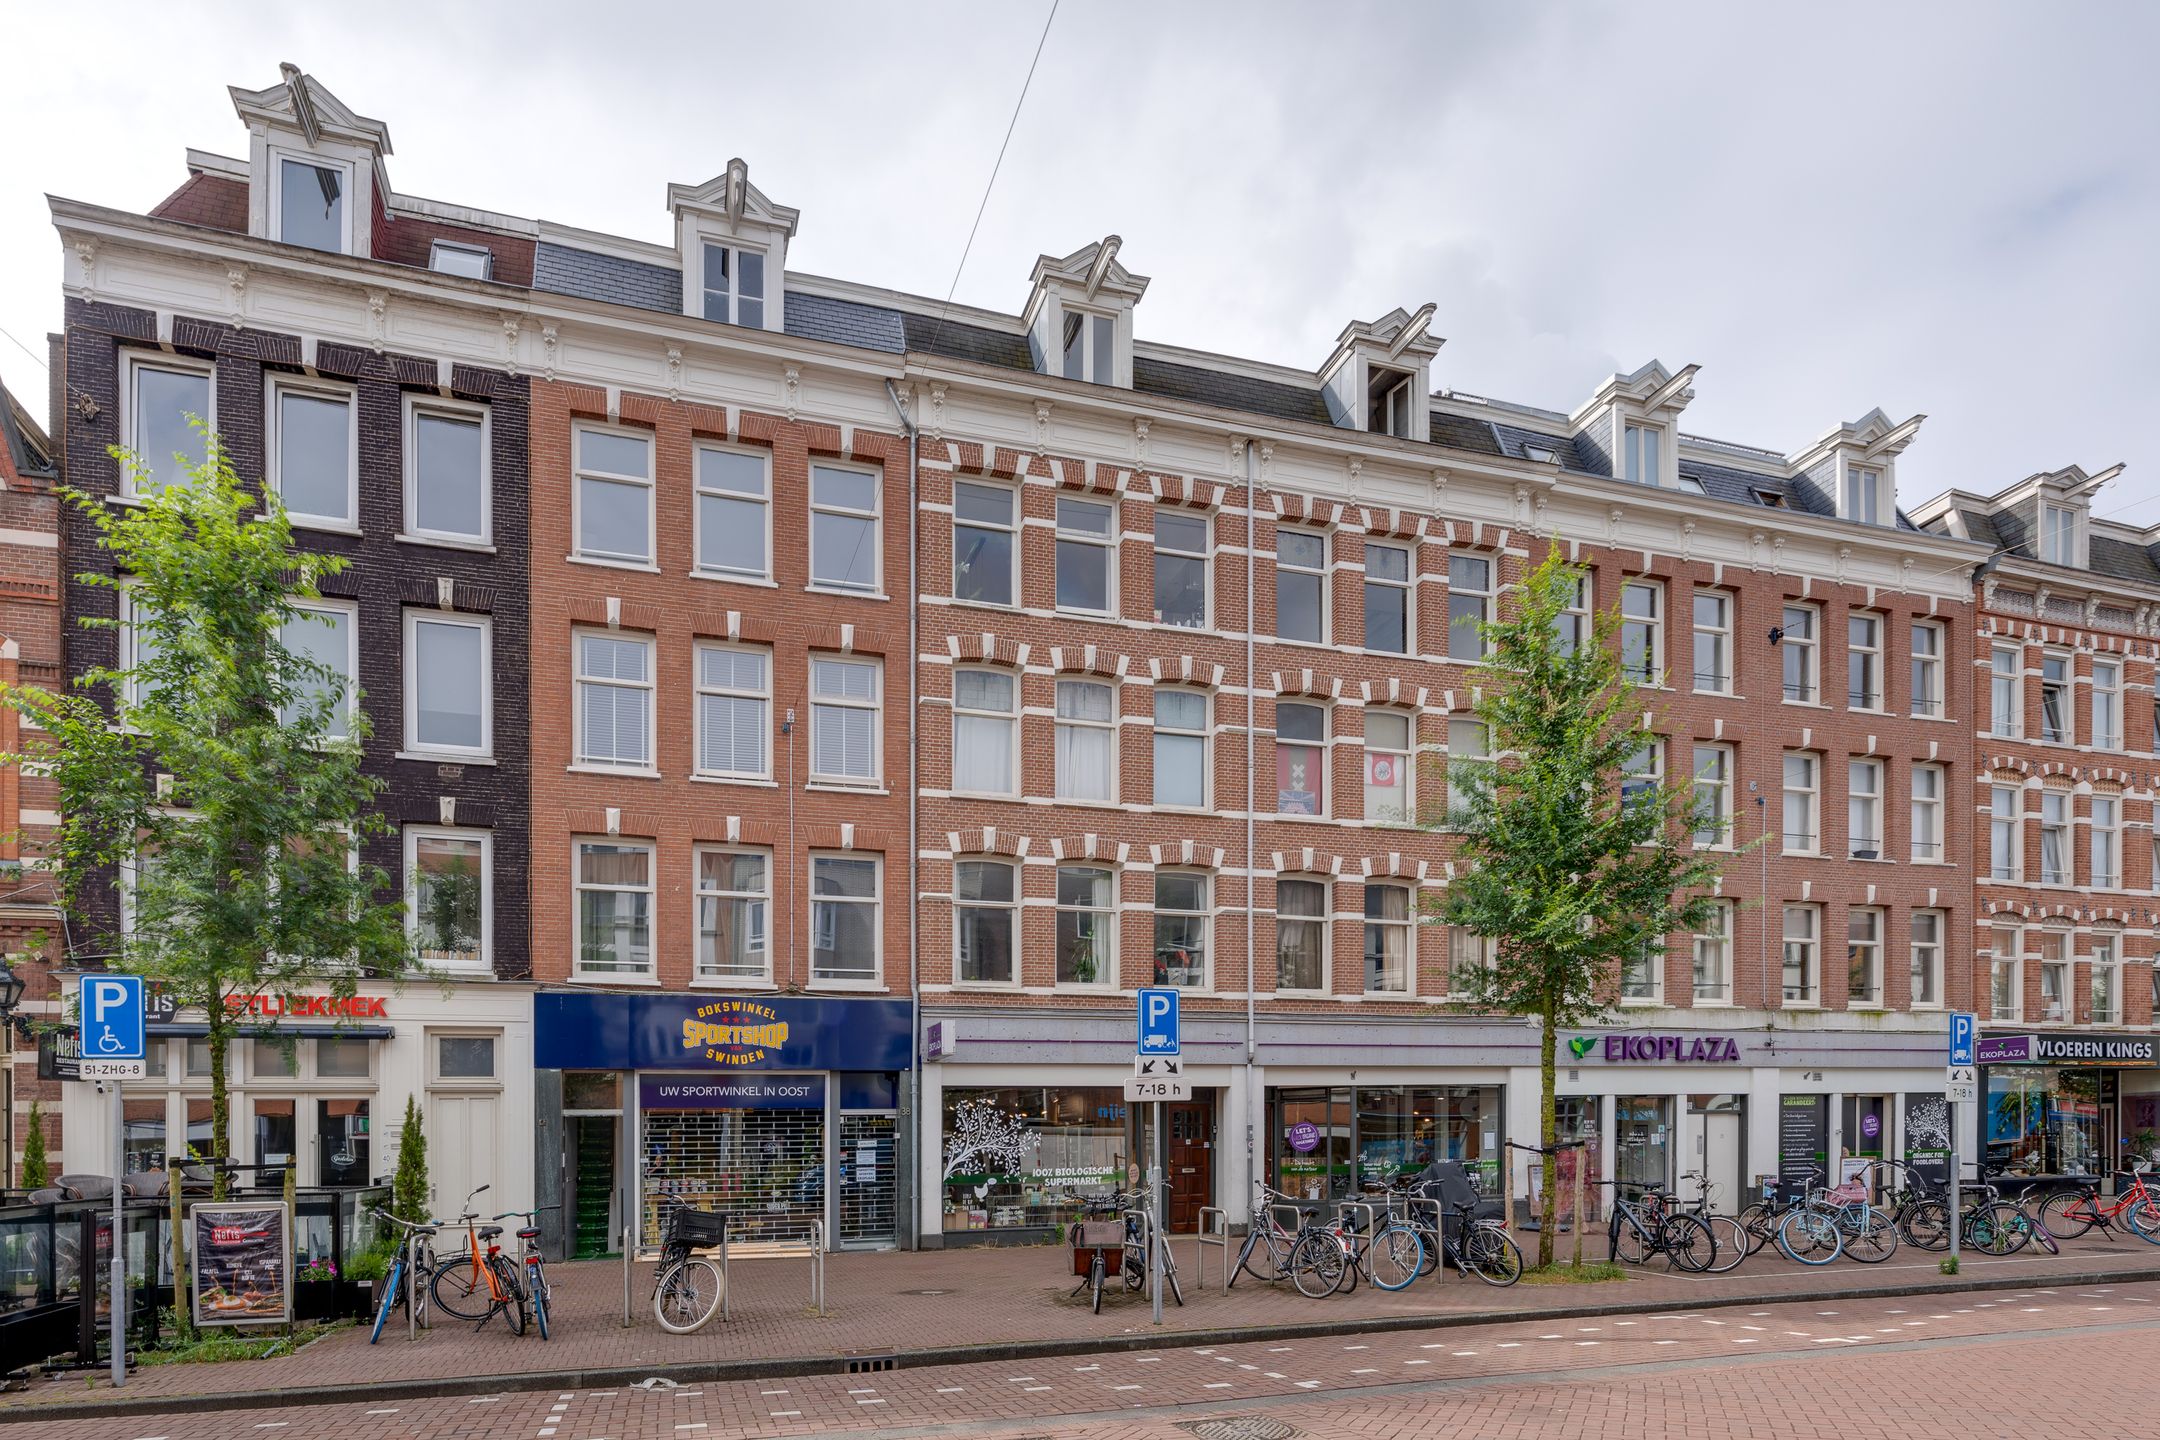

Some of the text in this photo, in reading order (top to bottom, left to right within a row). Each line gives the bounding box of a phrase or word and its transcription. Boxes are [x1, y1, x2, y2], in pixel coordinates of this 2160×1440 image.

[95, 982, 128, 1023] P
[290, 995, 388, 1017] EKMEK
[697, 1001, 776, 1020] BOKSWINKEL
[1149, 995, 1171, 1027] P
[683, 1018, 788, 1050] SPORTSHOP
[1956, 1018, 1968, 1044] P
[1605, 1036, 1741, 1061] EKOPLAZA
[1980, 1049, 2026, 1059] EKOPLAZA
[2037, 1040, 2152, 1059] VLOEREN KINGS
[706, 1049, 765, 1065] SWINDEN
[85, 1065, 140, 1075] 51-ZHG-8
[659, 1086, 810, 1096] UW SPORTWINKEL IN OOST
[1136, 1084, 1181, 1095] 7-18 h
[1953, 1088, 1967, 1098] 7-18
[901, 1107, 911, 1115] 38
[1032, 1166, 1114, 1177] 100% BIOLOGISCHE
[1044, 1177, 1102, 1187] SUPERMARKT
